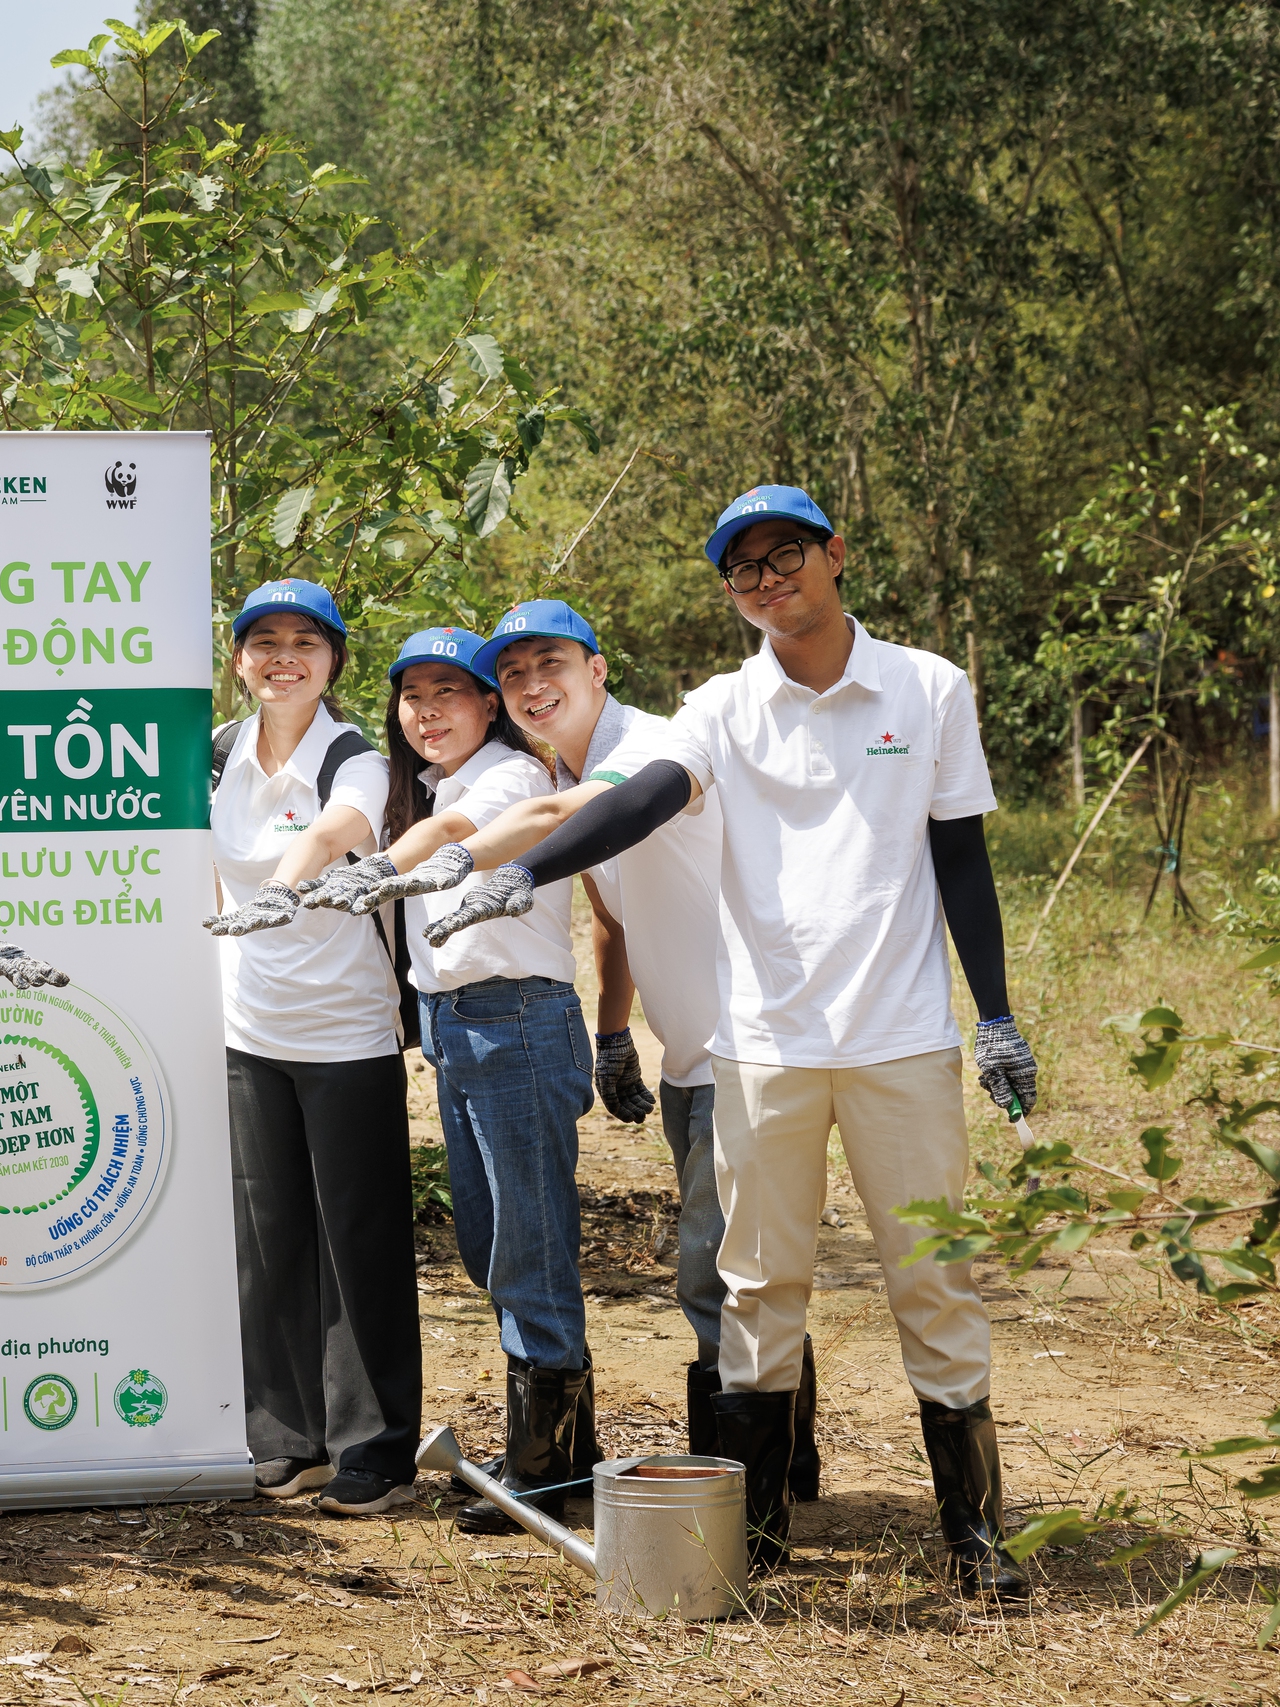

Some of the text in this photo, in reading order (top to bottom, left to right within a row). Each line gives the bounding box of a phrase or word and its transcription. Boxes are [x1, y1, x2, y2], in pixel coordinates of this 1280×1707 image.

[105, 499, 138, 510] WWF
[51, 560, 152, 603] TAY
[2, 616, 153, 677] ĐỘNG
[431, 640, 458, 657] 0.0
[7, 697, 160, 780] TỒN
[866, 745, 909, 756] Heineken
[64, 785, 162, 821] NƯỚC
[1, 847, 72, 878] LƯU
[85, 845, 162, 884] VỰC
[73, 882, 163, 926] ĐIỂM
[92, 1021, 101, 1031] &
[97, 1026, 118, 1049] THIÊN
[113, 1045, 133, 1070] NHIÊN
[0, 1081, 40, 1105] MỘT
[129, 1076, 143, 1095] MỰC
[10, 1105, 53, 1128] NAM
[35, 1126, 76, 1149] HƠN
[135, 1124, 148, 1147] UỐNG
[11, 1161, 32, 1175] CAM
[32, 1155, 48, 1171] KẾT
[50, 1155, 70, 1169] 2030
[131, 1154, 145, 1175] TOÀN
[48, 1114, 133, 1240] UỐNG CÓ TRÁCH NHIỆM
[126, 1175, 138, 1189] AN
[115, 1186, 133, 1209] UỐNG
[73, 1241, 81, 1251] &
[79, 1224, 104, 1247] KHÔNG
[25, 1254, 37, 1268] ĐỘ
[53, 1243, 73, 1260] THẤP
[1, 1339, 31, 1359] địa
[37, 1337, 109, 1360] phương
